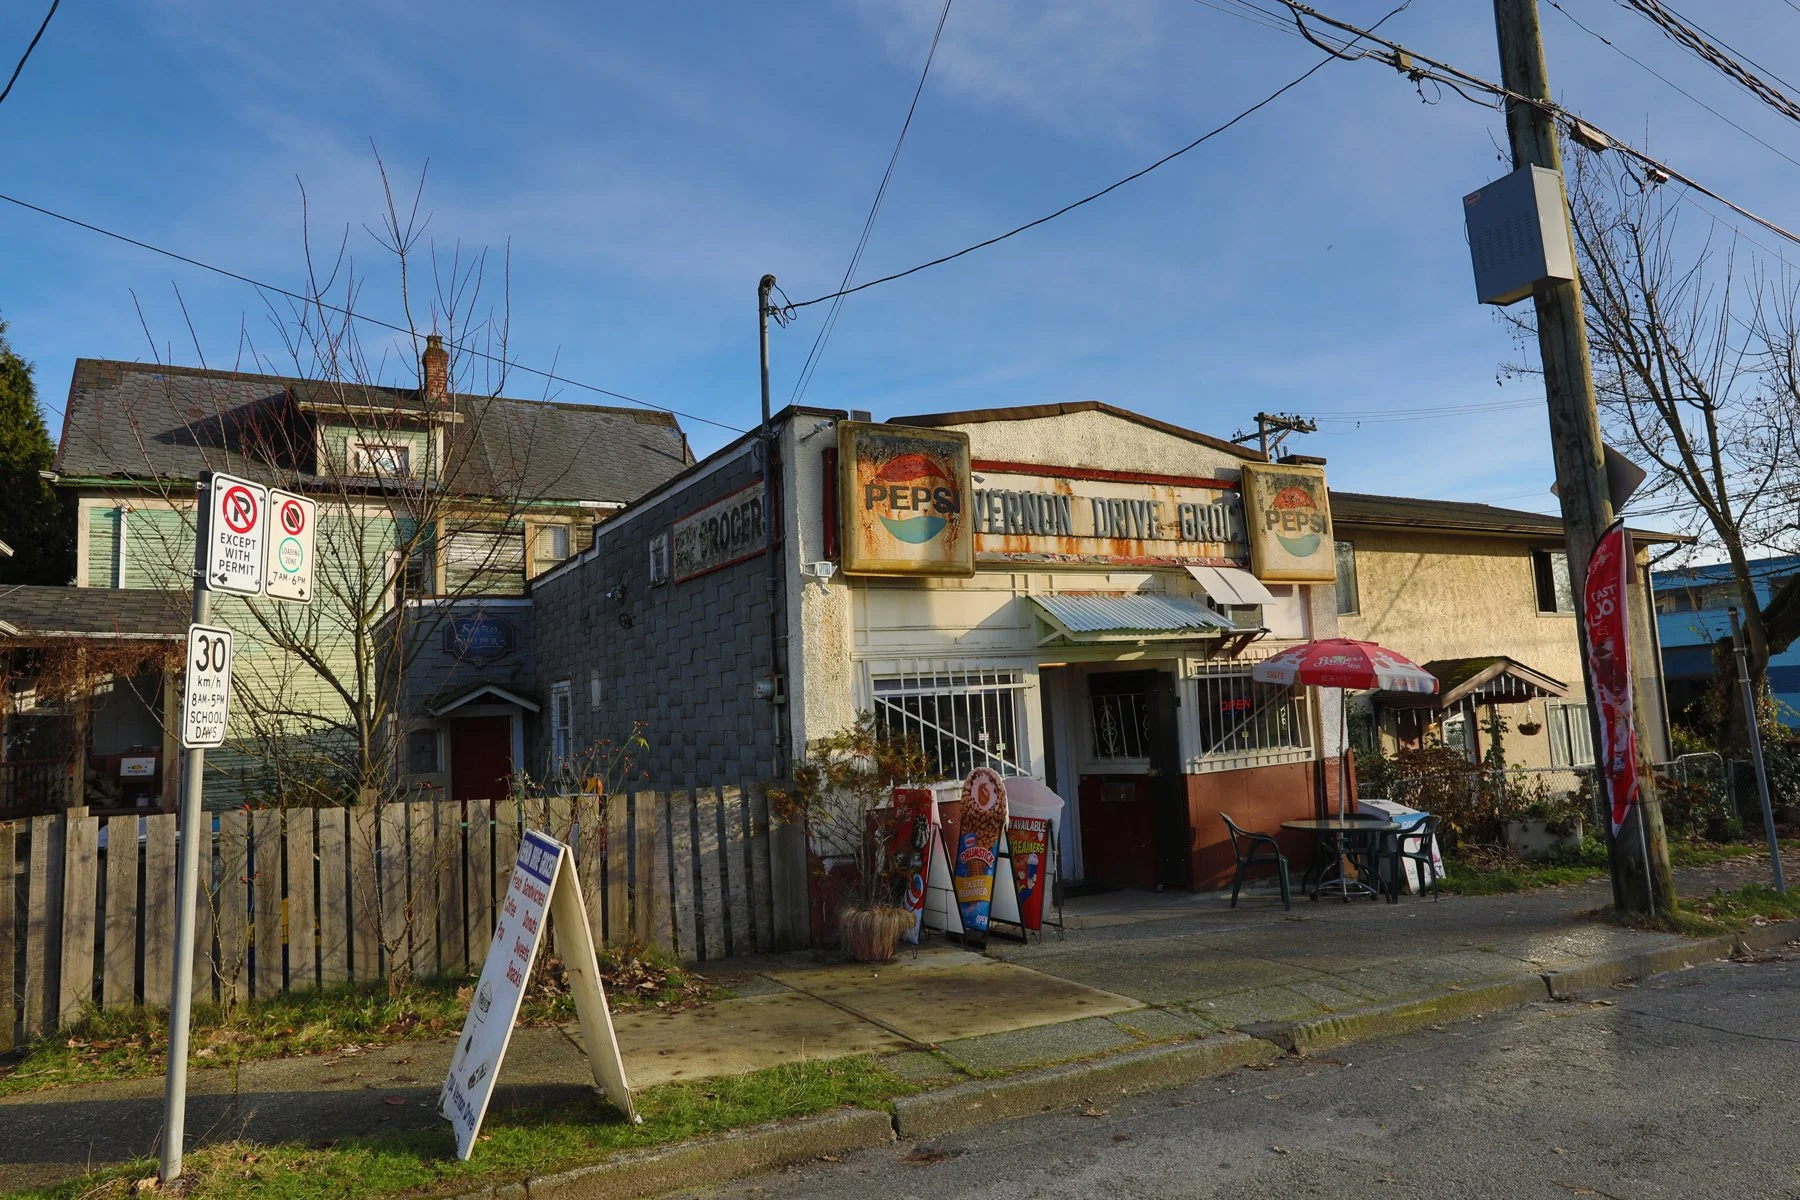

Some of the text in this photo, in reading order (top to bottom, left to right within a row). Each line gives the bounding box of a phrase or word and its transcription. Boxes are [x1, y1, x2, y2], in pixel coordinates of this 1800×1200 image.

[865, 484, 960, 514] PEPSI
[972, 489, 1073, 536] VERNON
[1092, 497, 1163, 541] DRIVE
[1265, 510, 1327, 534] PEPSI
[220, 533, 257, 550] EXCEPT
[225, 547, 250, 562] WITH
[282, 547, 301, 557] LOADING
[219, 560, 255, 576] PERMIT
[285, 557, 297, 566] ZONE
[196, 635, 226, 673] 30
[197, 675, 221, 689] km/h
[1220, 697, 1251, 711] OPEN
[190, 711, 223, 724] SCHOOL
[195, 726, 217, 739] DAYS
[1014, 819, 1047, 833] AVAILABLE
[1010, 840, 1045, 856] REAMERS
[960, 846, 996, 868] DRUMSTICK
[964, 879, 985, 889] TASTE
[959, 887, 988, 898] SUMMER
[463, 1102, 476, 1132] Drive
